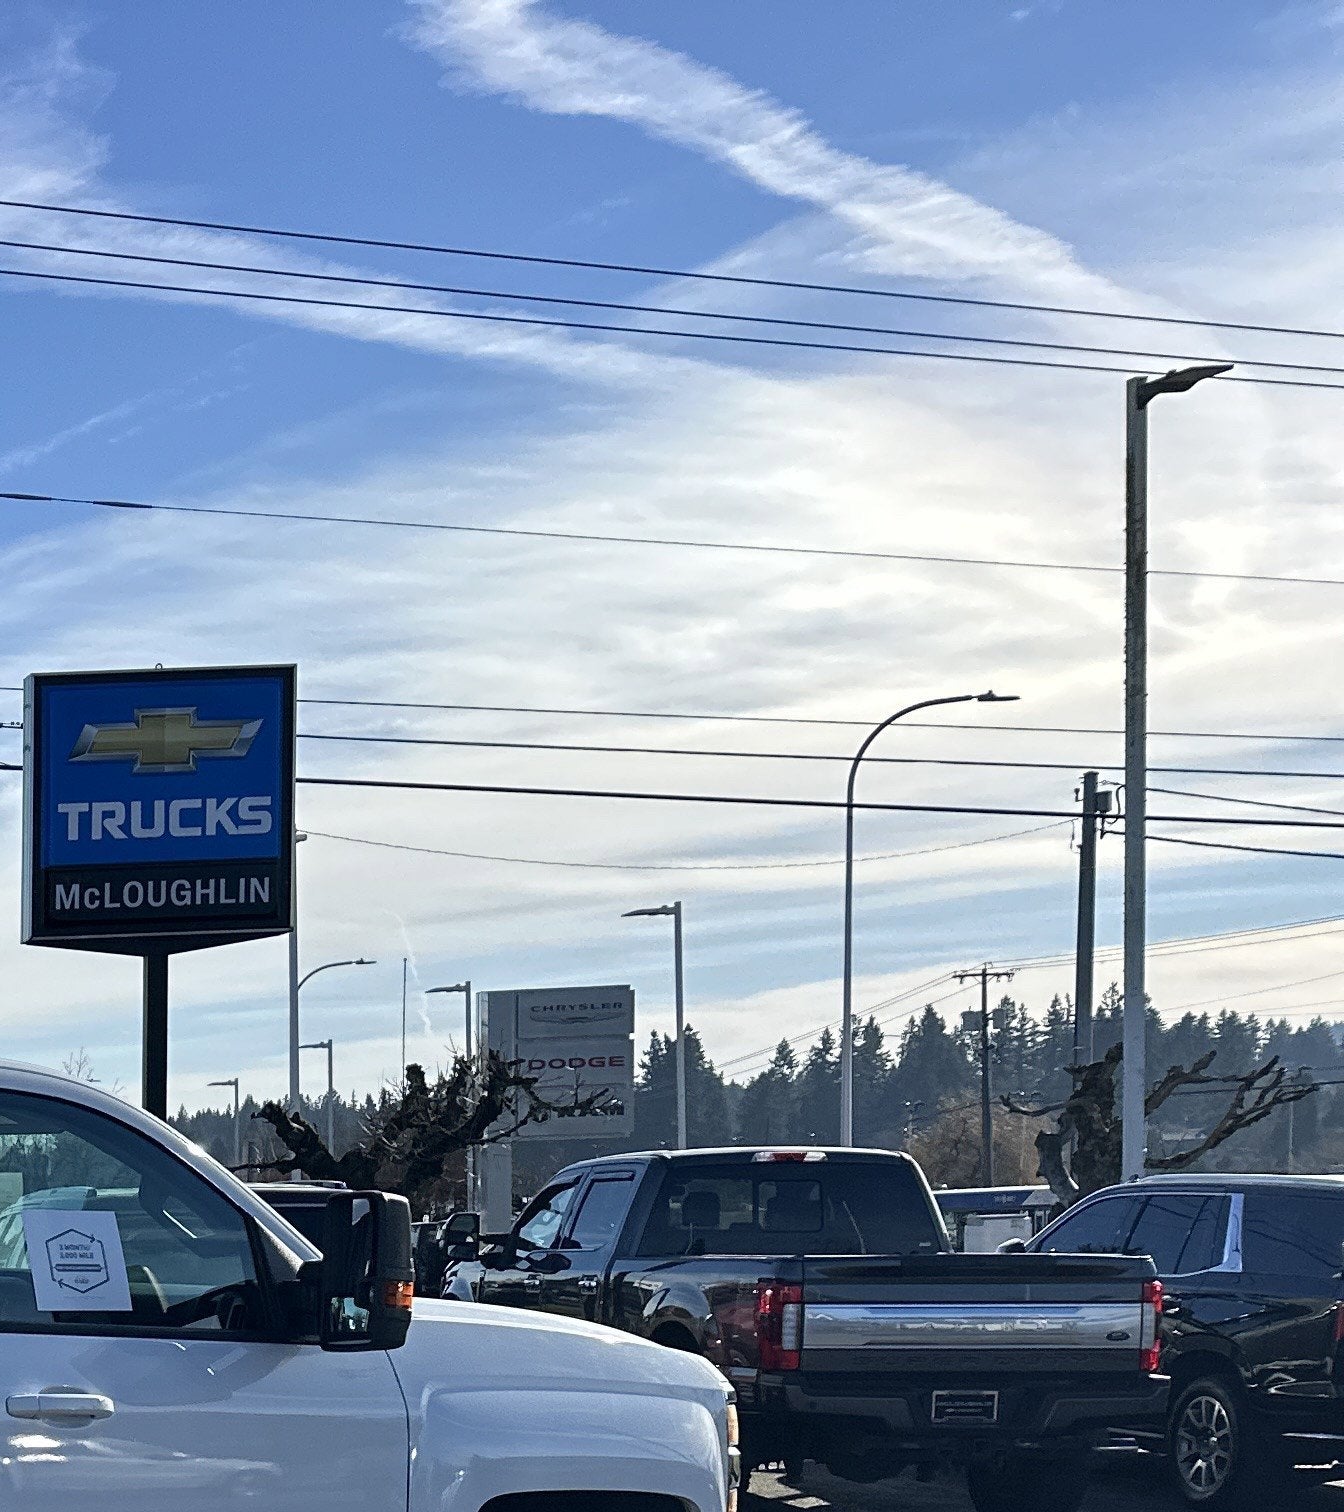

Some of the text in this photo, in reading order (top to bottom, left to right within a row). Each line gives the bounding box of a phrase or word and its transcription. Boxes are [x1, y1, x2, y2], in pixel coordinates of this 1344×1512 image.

[57, 796, 273, 841] TRUCKS
[55, 876, 271, 911] McLOUGHLIN
[530, 1001, 624, 1013] CHRYSLER
[528, 1055, 626, 1071] DODGE
